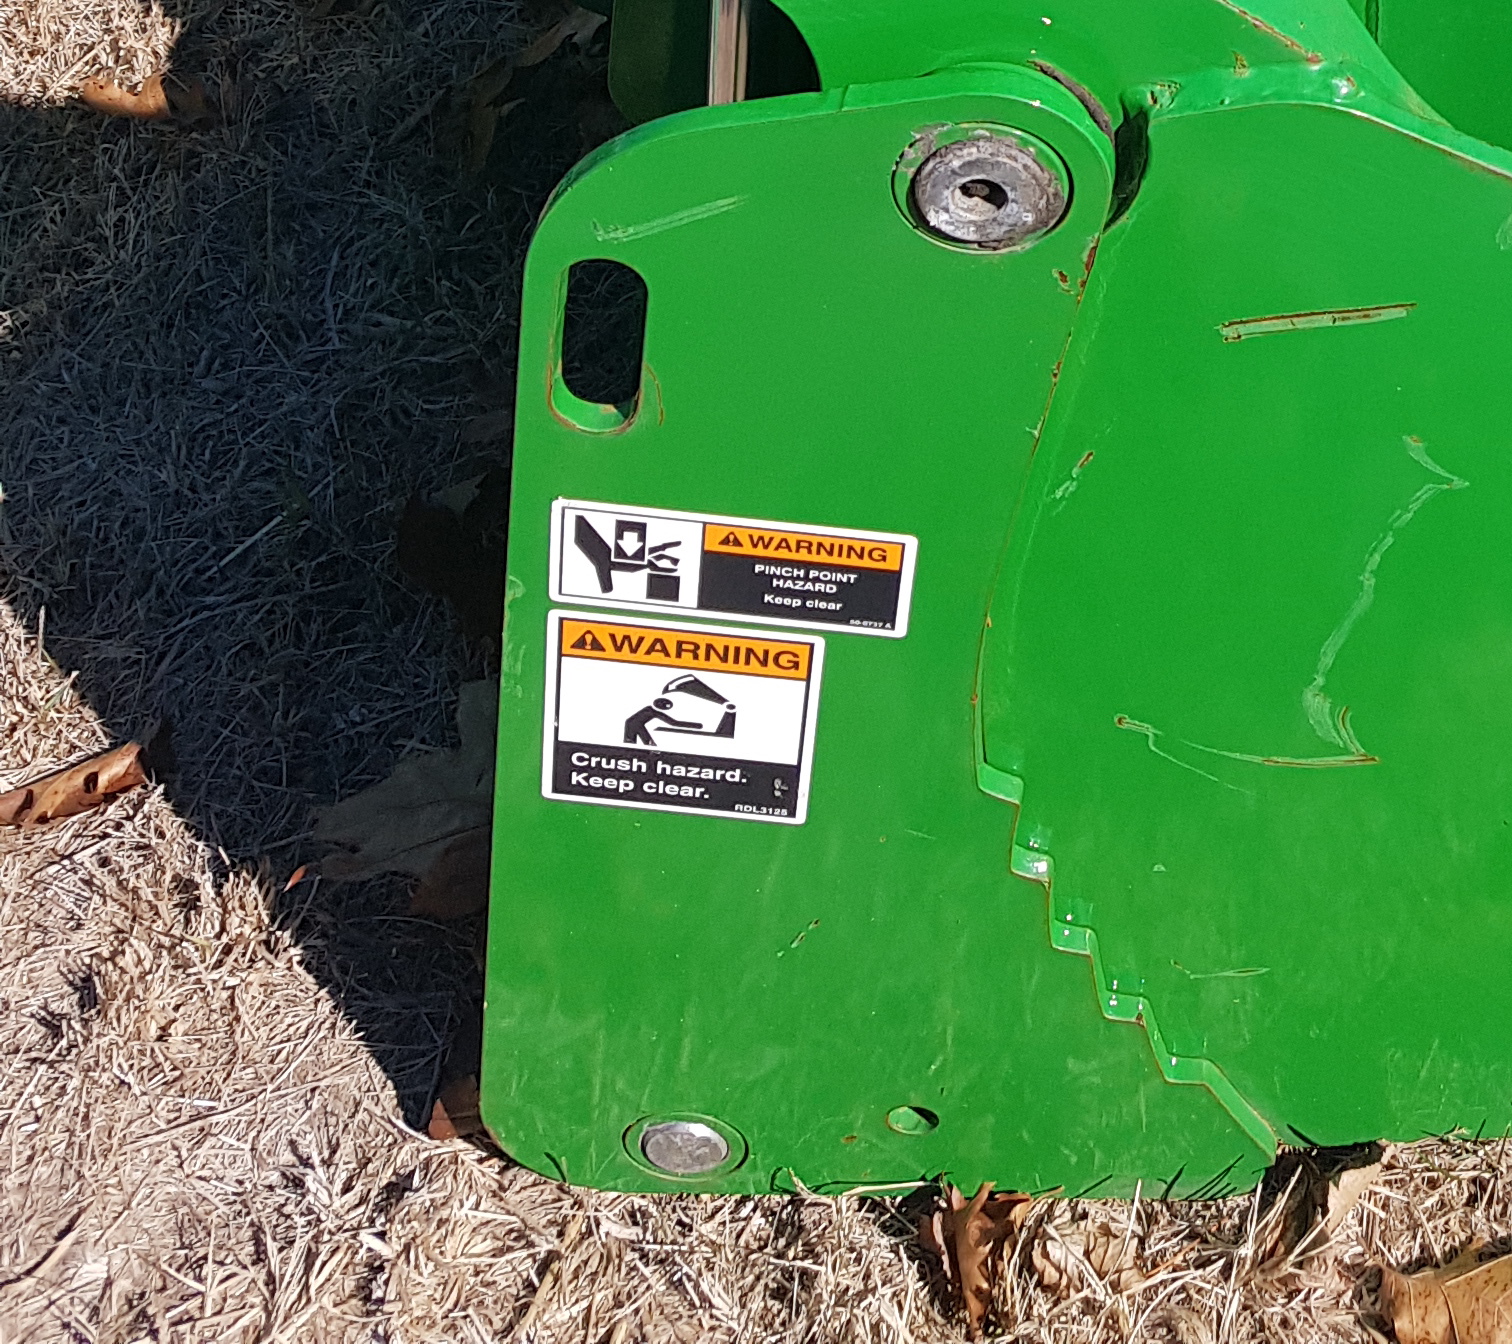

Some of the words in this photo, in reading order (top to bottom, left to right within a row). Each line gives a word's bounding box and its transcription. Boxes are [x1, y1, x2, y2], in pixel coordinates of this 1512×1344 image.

[748, 533, 888, 563] WARNING
[754, 564, 805, 578] PINCH
[808, 570, 858, 584] POINT
[772, 578, 838, 594] HAZARD
[763, 593, 802, 608] Keep
[805, 599, 843, 611] clear
[608, 632, 801, 671] WARNING
[571, 752, 647, 773] Crush
[656, 760, 748, 783] hazard.
[571, 771, 635, 793] Keep
[642, 780, 710, 799] clear.
